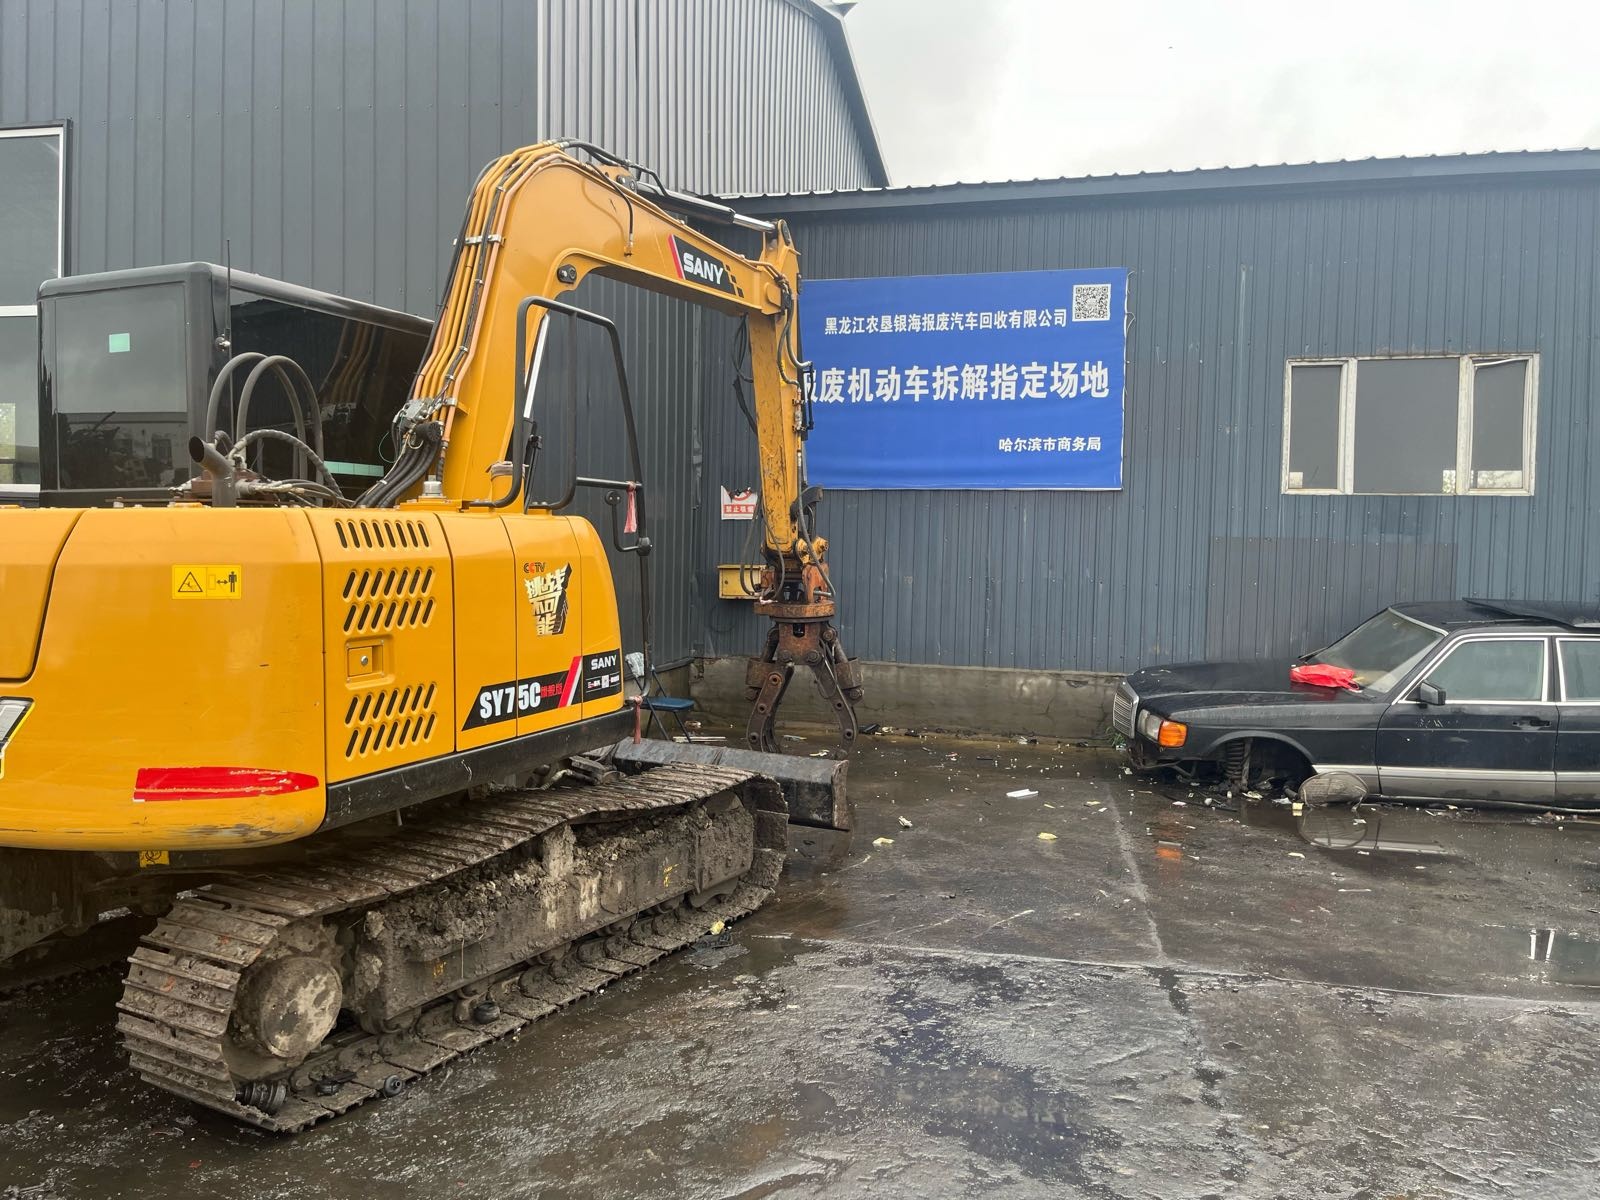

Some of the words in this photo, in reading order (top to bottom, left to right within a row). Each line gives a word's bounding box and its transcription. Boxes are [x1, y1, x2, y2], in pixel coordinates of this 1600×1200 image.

[683, 252, 724, 284] SANY
[825, 309, 1067, 335] 黑龙江农垦银海报废汽车回收有限公司
[998, 437, 1101, 452] 哈尔滨市商务局
[523, 562, 546, 574] CCTV
[591, 655, 617, 671] SANY
[479, 682, 541, 719] SY75C
